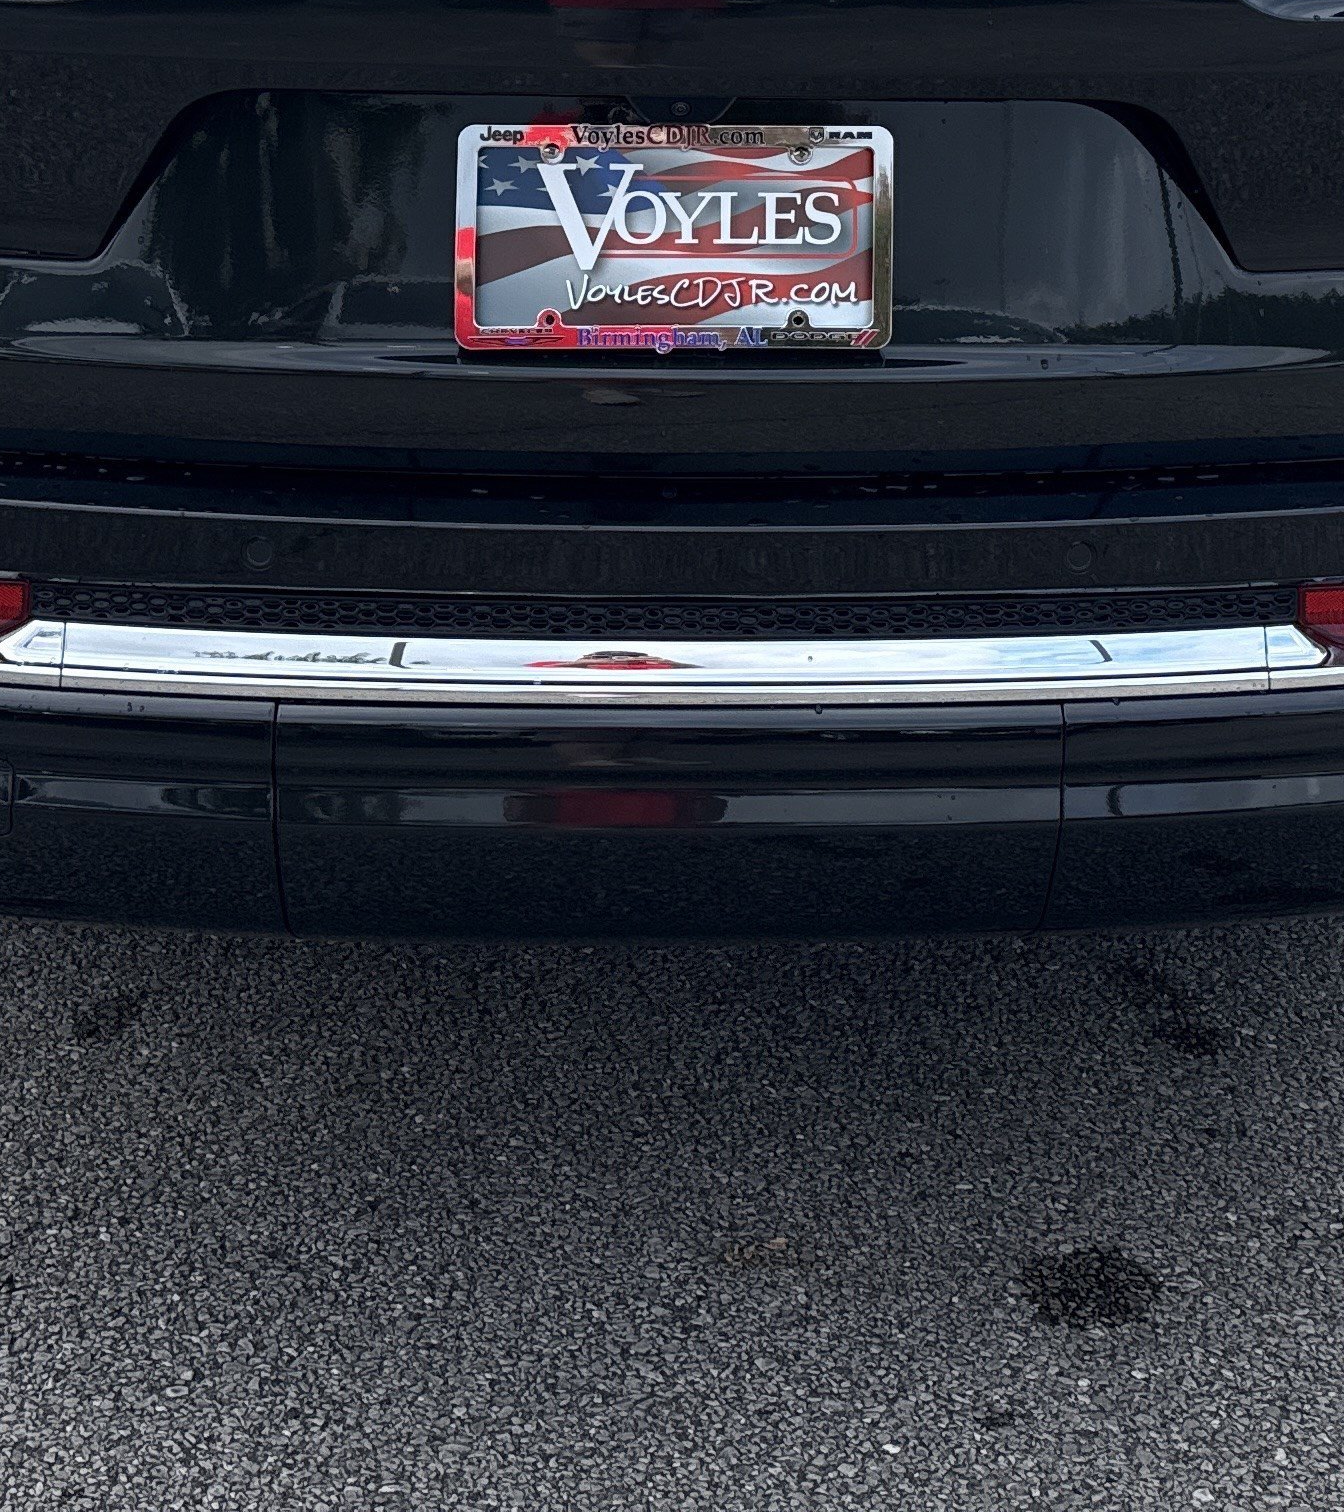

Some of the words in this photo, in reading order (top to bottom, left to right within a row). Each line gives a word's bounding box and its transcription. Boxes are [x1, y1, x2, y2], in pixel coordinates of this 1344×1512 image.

[479, 126, 525, 144] Jeep
[570, 124, 766, 149] VoylesCDJR.com
[536, 163, 841, 270] VOYLES
[577, 327, 728, 351] Birmingham,
[734, 327, 768, 346] AL
